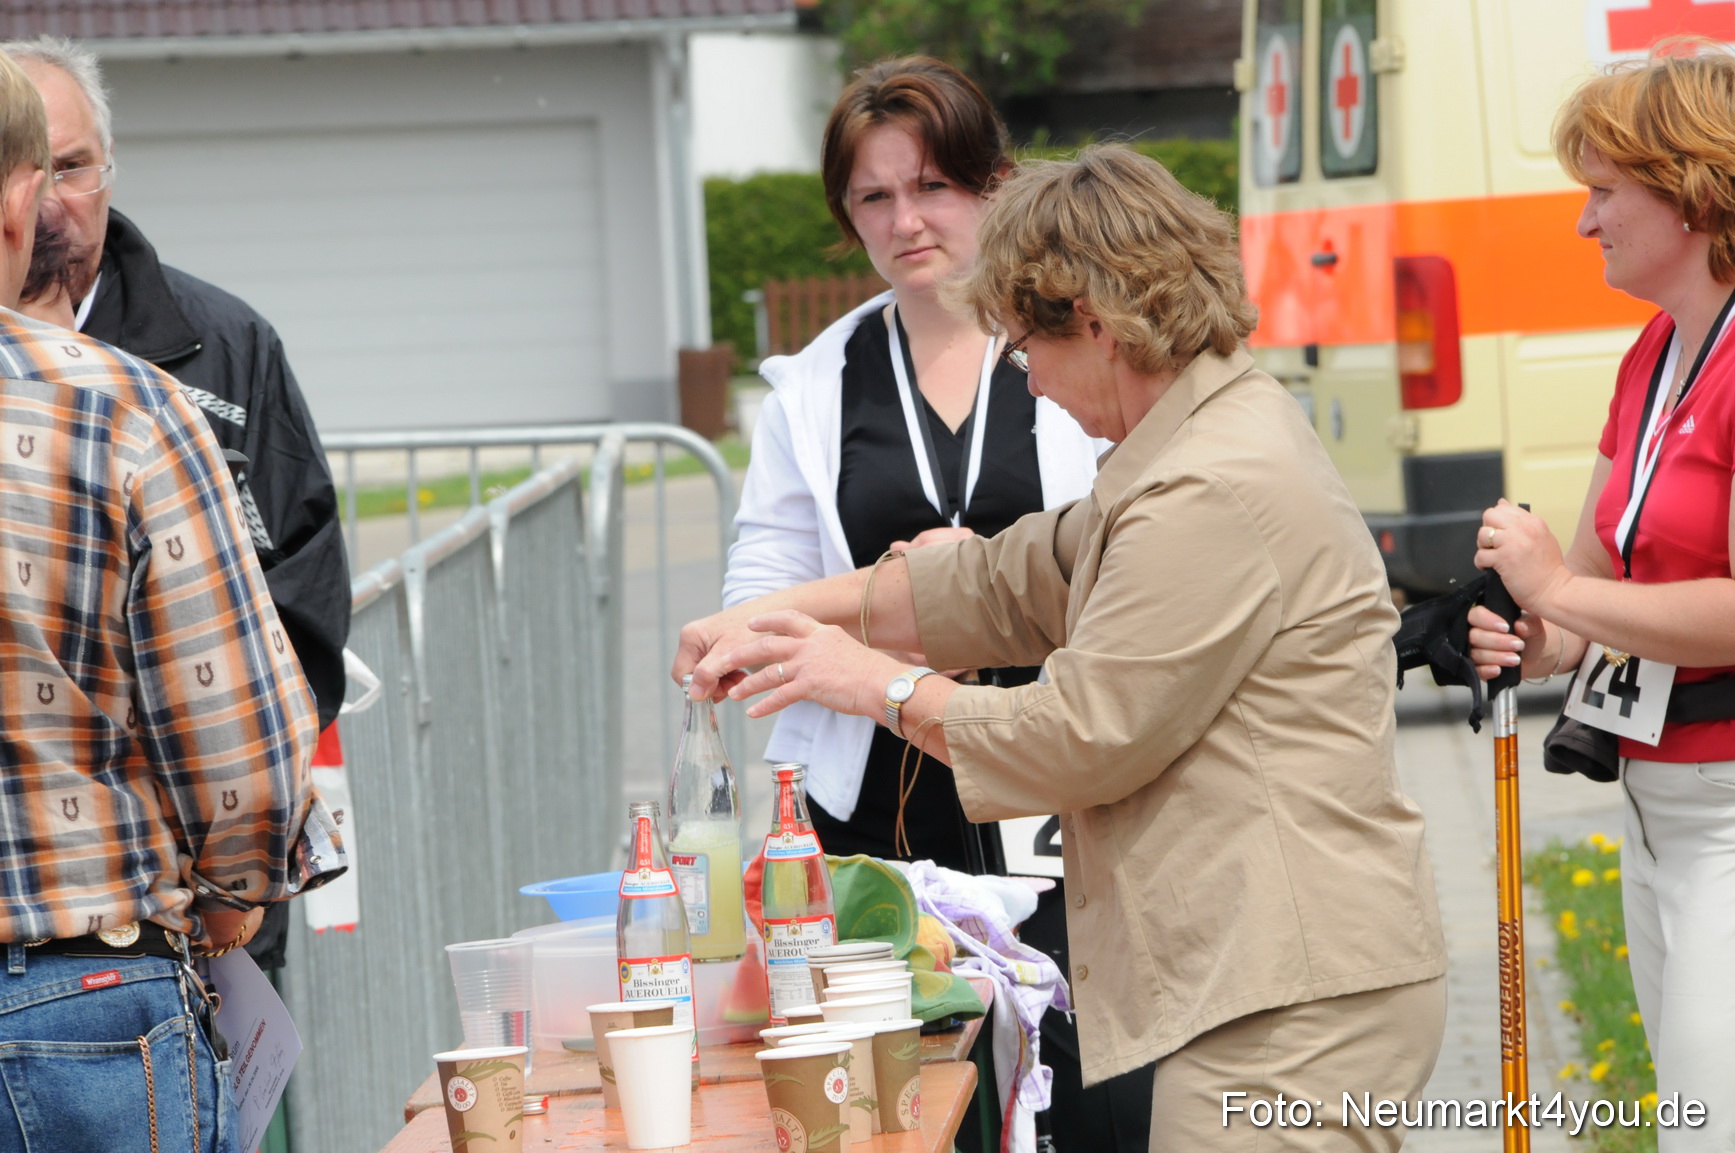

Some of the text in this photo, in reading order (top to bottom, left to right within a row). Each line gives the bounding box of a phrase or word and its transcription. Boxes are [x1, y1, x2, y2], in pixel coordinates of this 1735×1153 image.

[774, 938, 820, 950] Bissinger
[633, 978, 680, 989] Bissinger
[1499, 920, 1514, 1064] KOMPERDELL
[449, 1079, 475, 1098] SPECIALTY
